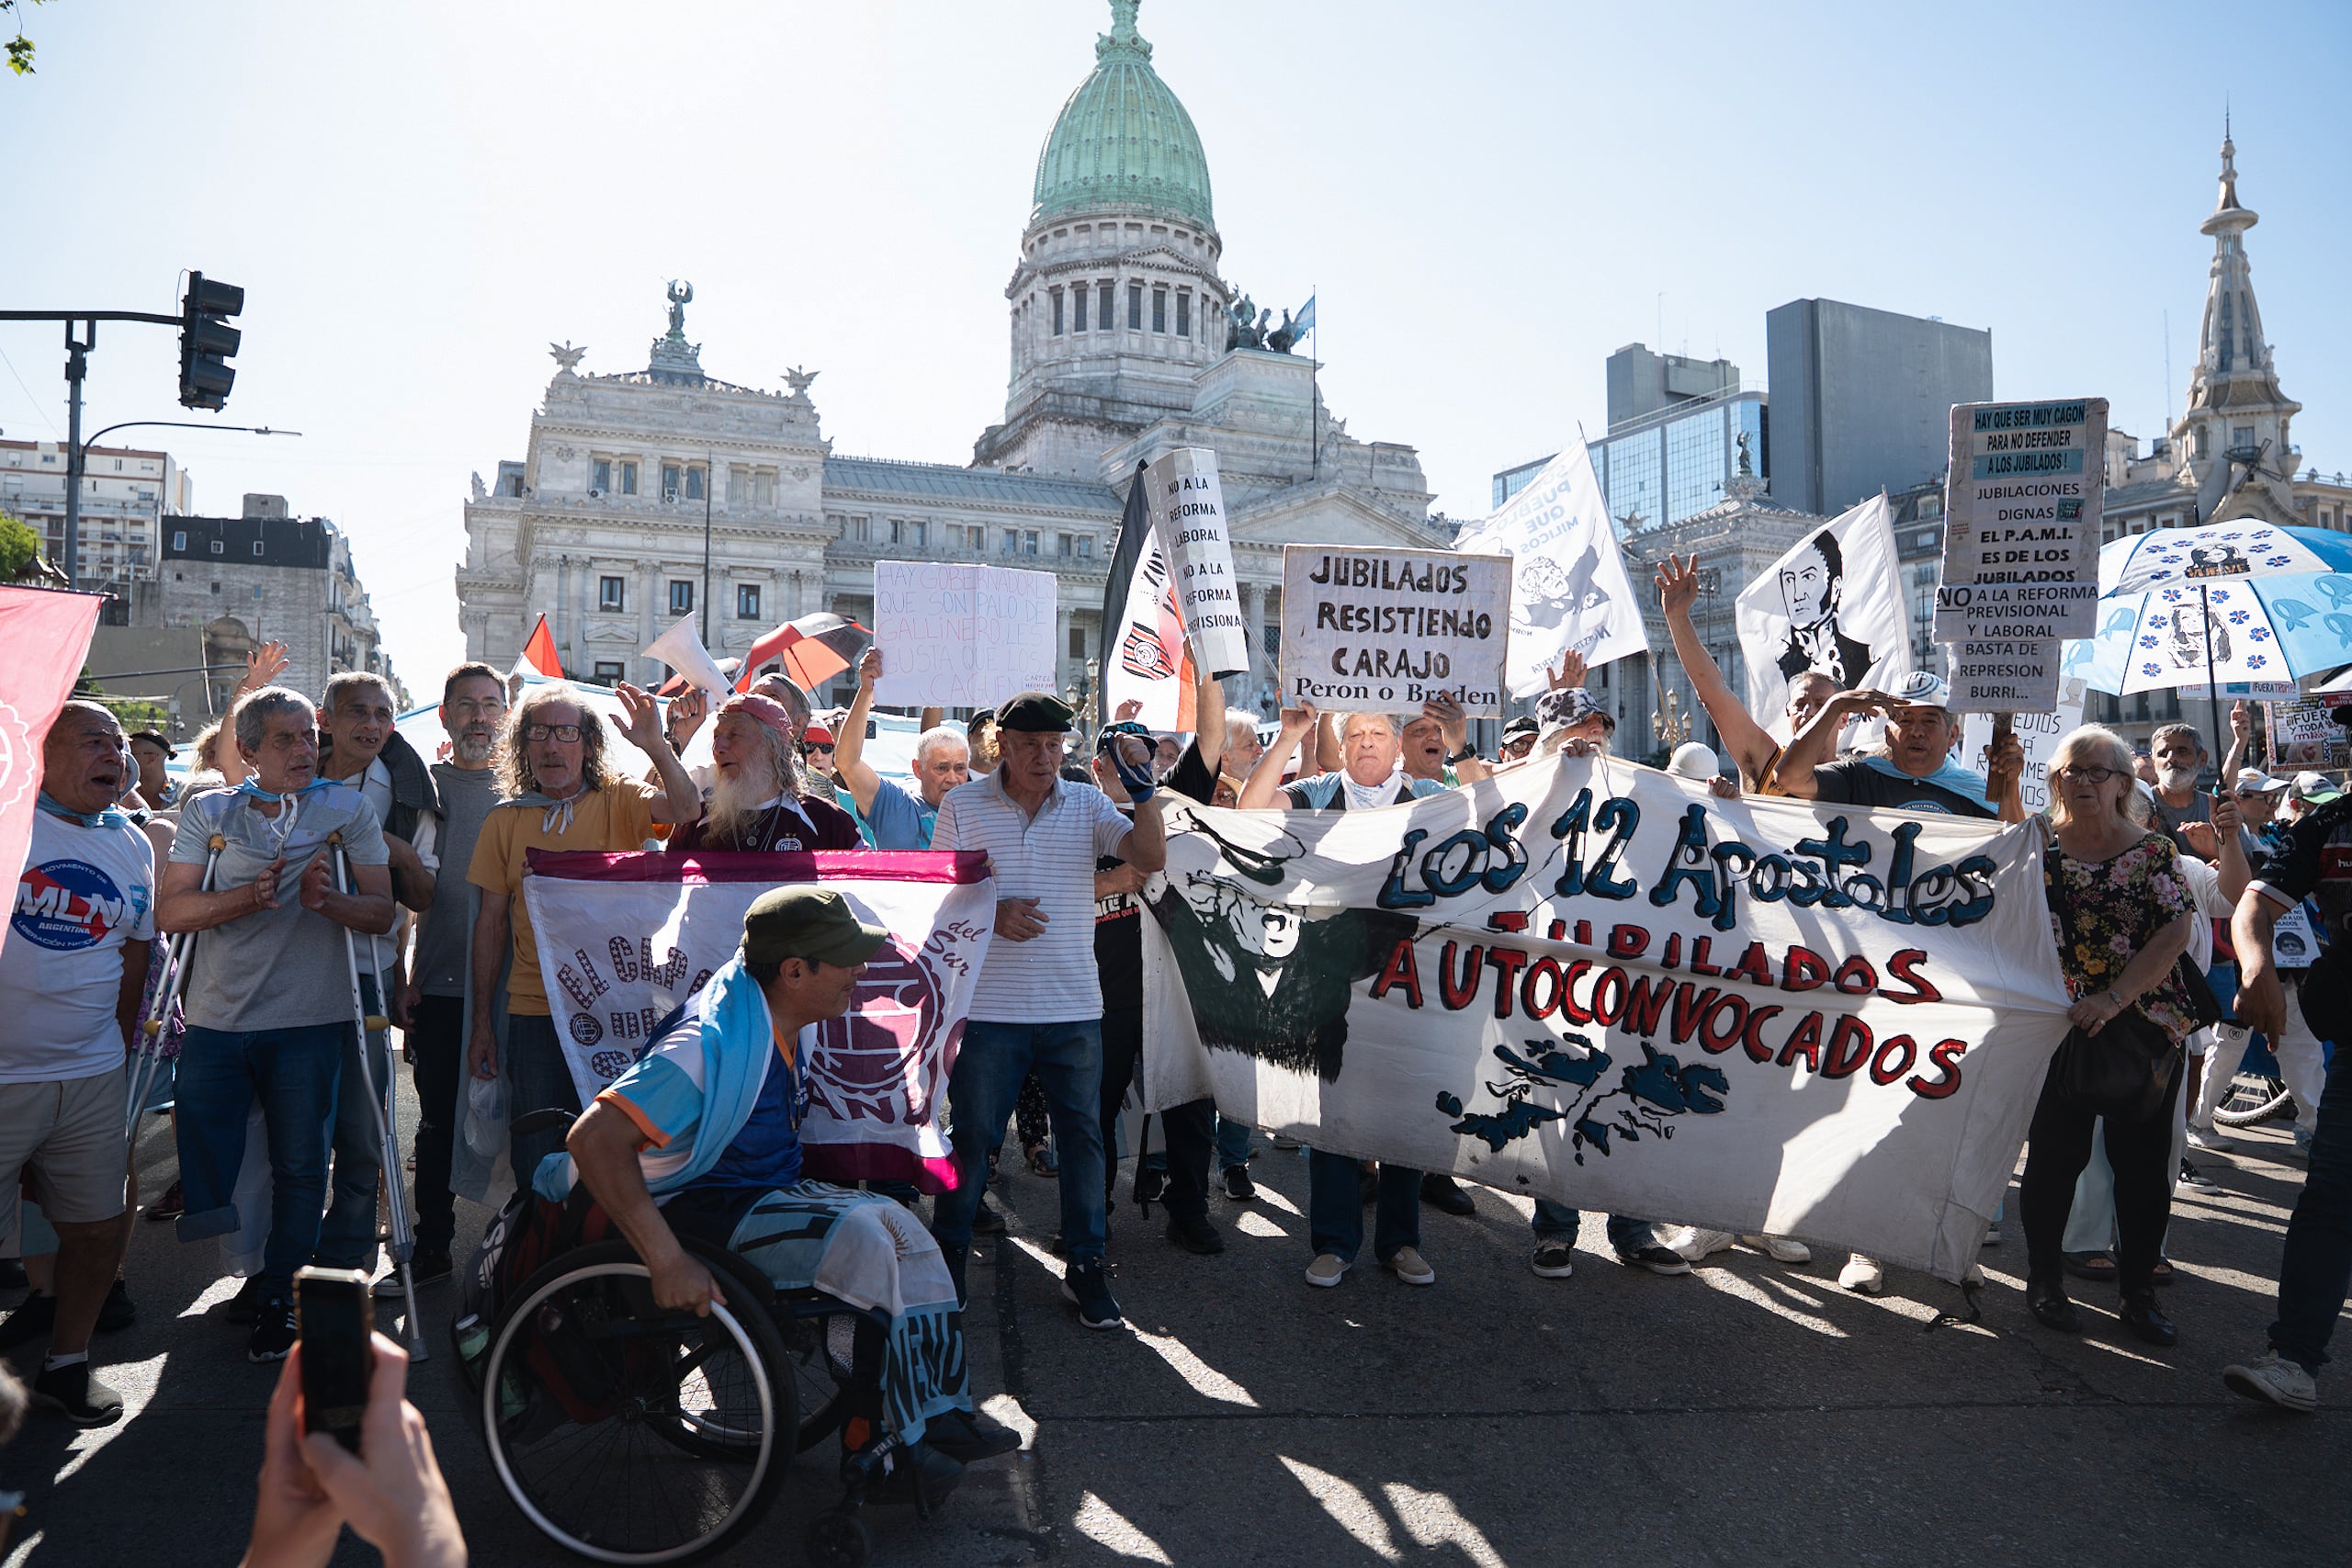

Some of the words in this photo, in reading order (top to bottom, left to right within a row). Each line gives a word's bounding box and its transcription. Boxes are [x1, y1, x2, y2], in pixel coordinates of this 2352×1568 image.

[1975, 412, 1991, 430] HAY
[1994, 412, 2011, 428] QUE
[2014, 410, 2030, 427] SER
[2033, 408, 2052, 425] MUY
[2054, 405, 2085, 423] CAGON
[1987, 434, 2008, 451] PARA
[2011, 433, 2023, 449] NO
[2025, 430, 2071, 448] DEFENDER
[1987, 457, 1995, 474] A
[1996, 457, 2011, 473] LOS
[2014, 453, 2063, 471] JUBILADOS
[1169, 481, 1180, 497] NO
[1184, 478, 1193, 491] A
[1195, 477, 1209, 490] LA
[1977, 483, 2079, 500] JUBILACIONES
[1169, 503, 1217, 523] REFORMA
[1998, 507, 2054, 521] DIGNAS
[1174, 529, 1220, 548] LABORAL
[1981, 531, 1999, 543] EL
[2005, 527, 2073, 541] P.A.M.I.
[1982, 551, 1999, 564] ES
[2006, 550, 2029, 563] DE
[2034, 549, 2070, 562] LOS
[1183, 565, 1194, 581] NO
[1199, 563, 1207, 576] A
[1210, 562, 1224, 575] LA
[1973, 570, 2075, 585] JUBILADOS
[878, 566, 917, 587] HAY
[920, 566, 1056, 599] GOBERNADORES
[1185, 589, 1232, 608] REFORMA
[1937, 587, 1973, 607] NO
[1977, 590, 1987, 602] A
[1992, 589, 2009, 602] LA
[2018, 586, 2098, 601] REFORMA
[878, 591, 917, 614] QUE
[929, 592, 967, 616] SON
[978, 592, 1017, 619] PALO
[1026, 602, 1046, 624] DE
[1967, 604, 2069, 618] PREVISIONAL
[1968, 625, 1976, 637] Y
[1984, 625, 2055, 637] LABORAL
[1966, 643, 2014, 655] BASTA
[2018, 643, 2039, 655] DE
[883, 646, 954, 674] GUSTA
[962, 646, 998, 671] QUE
[1008, 650, 1042, 673] LOS
[1331, 648, 1451, 679] CARAJO
[1960, 665, 2043, 678] REPRESION
[1295, 678, 1370, 700] Peron
[1378, 687, 1394, 700] o
[1406, 682, 1497, 705] Braden
[1971, 685, 2029, 699] BURRI...
[2300, 722, 2324, 733] TODA
[1549, 786, 1642, 902] 12
[12, 881, 122, 928] MLN
[17, 920, 65, 947] LIBERACIÓN
[39, 922, 90, 934] ARGENTINA
[948, 919, 988, 942] del
[924, 930, 969, 976] Sur
[557, 948, 610, 1010] EL
[1369, 935, 1968, 1100] AUTOCONVOCADOS
